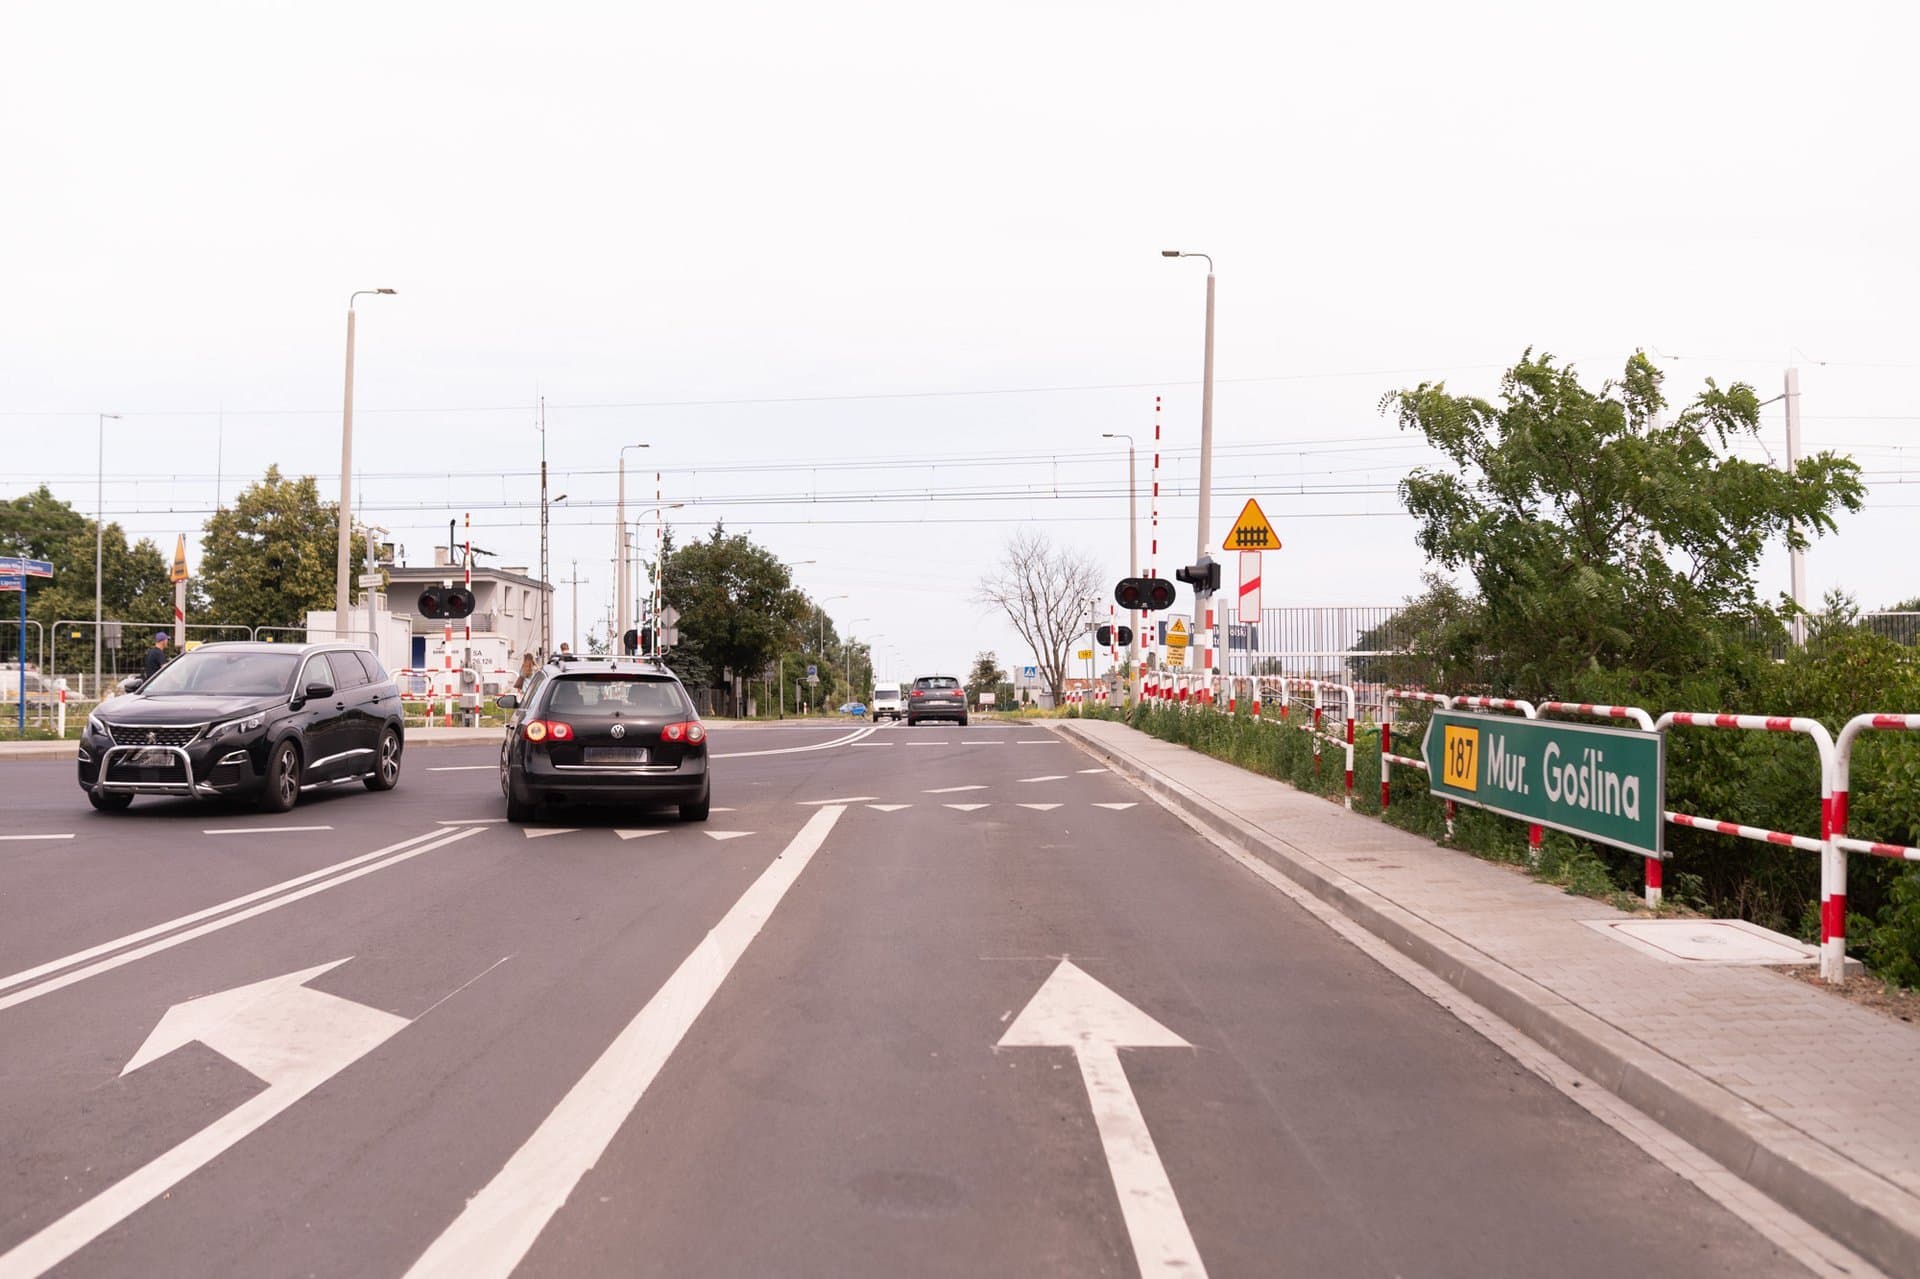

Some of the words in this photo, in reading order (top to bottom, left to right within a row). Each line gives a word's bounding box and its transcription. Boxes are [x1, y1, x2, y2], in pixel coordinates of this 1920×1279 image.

[1450, 736, 1473, 779] 187
[1487, 733, 1528, 794] Mur.
[1543, 741, 1640, 821] Goślina
